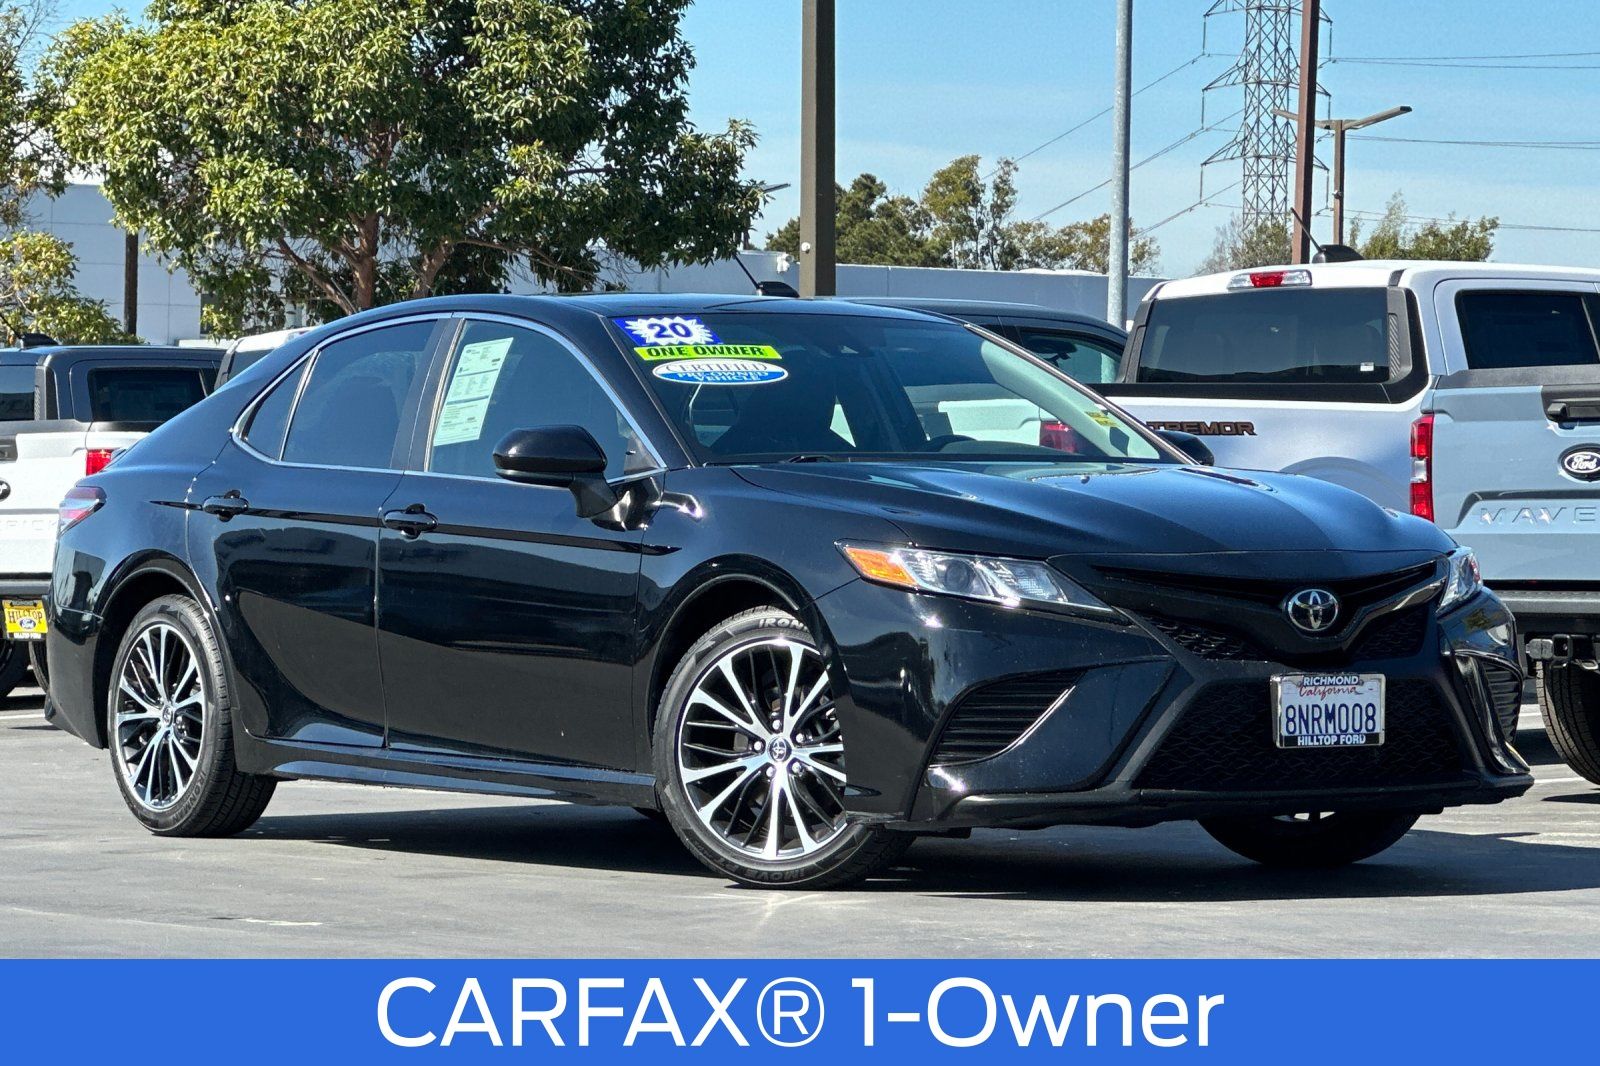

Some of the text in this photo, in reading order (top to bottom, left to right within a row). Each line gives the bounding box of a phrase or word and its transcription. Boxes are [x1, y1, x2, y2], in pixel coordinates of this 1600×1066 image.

[648, 321, 693, 339] 20
[646, 345, 764, 357] ONE OWNER
[665, 361, 768, 372] CERTIFIED
[1146, 421, 1257, 436] TREMOR
[1571, 454, 1597, 470] Ford
[8, 608, 43, 624] HILLTOP
[758, 617, 809, 632] IRON
[1303, 676, 1359, 686] RICHMOND
[1299, 684, 1364, 701] California
[1285, 702, 1376, 735] 8NRM008
[1297, 734, 1366, 746] HILLTOP FORD
